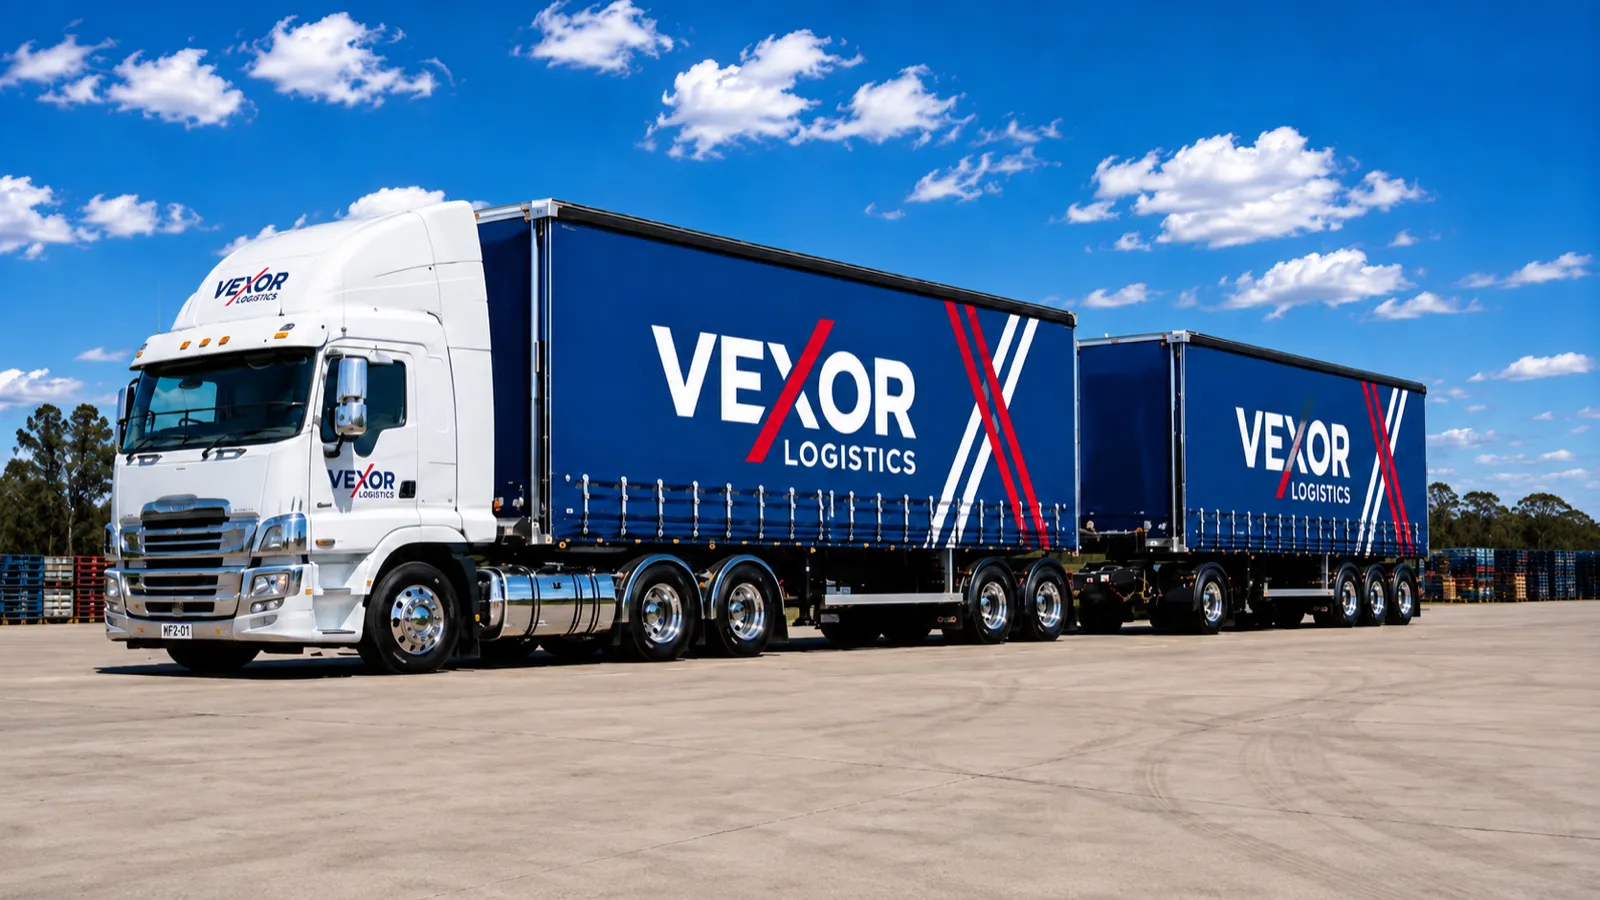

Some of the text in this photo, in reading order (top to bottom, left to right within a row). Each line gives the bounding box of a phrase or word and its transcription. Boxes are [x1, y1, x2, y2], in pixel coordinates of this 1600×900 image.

[214, 267, 289, 306] VEXOR
[236, 293, 278, 304] LOGISTICS
[651, 318, 917, 464] VEXOR
[784, 439, 917, 476] LOGISTICS
[1235, 396, 1351, 499] VEXOR
[327, 463, 395, 498] VEXOR
[358, 491, 394, 499] LOGISTICS
[1291, 481, 1351, 504] LOGISTICS
